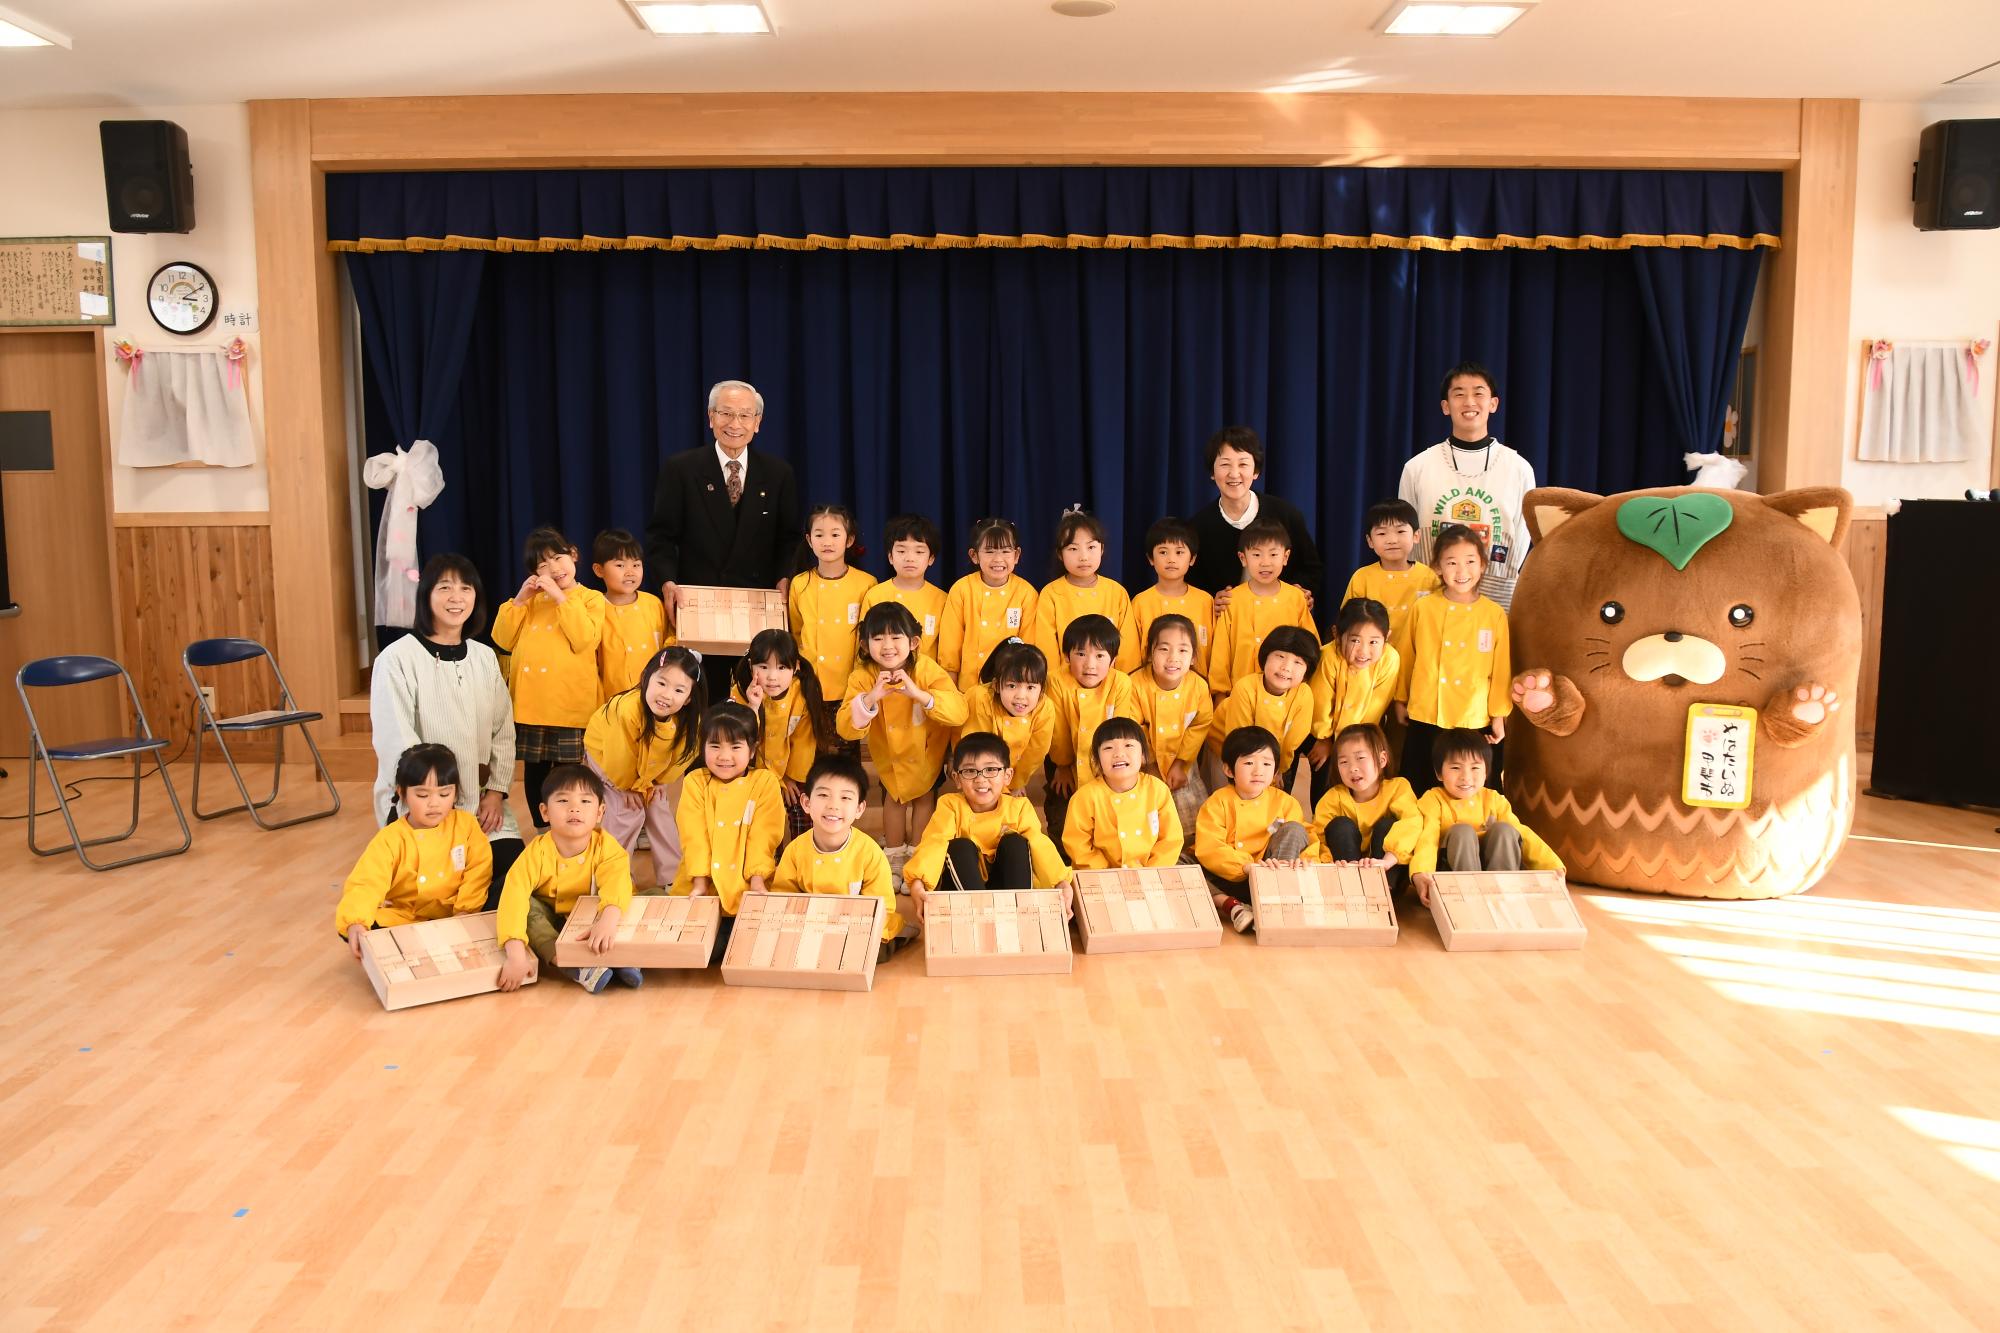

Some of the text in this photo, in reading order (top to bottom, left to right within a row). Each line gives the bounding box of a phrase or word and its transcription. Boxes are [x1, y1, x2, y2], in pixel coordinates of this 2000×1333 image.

[179, 272, 186, 280] 12
[160, 284, 168, 292] 10
[200, 306, 205, 314] 4
[193, 315, 198, 323] 5
[224, 313, 252, 326] 時計
[1431, 487, 1502, 543] BE WILD AND FREE
[1720, 722, 1738, 796] やはたいぬ
